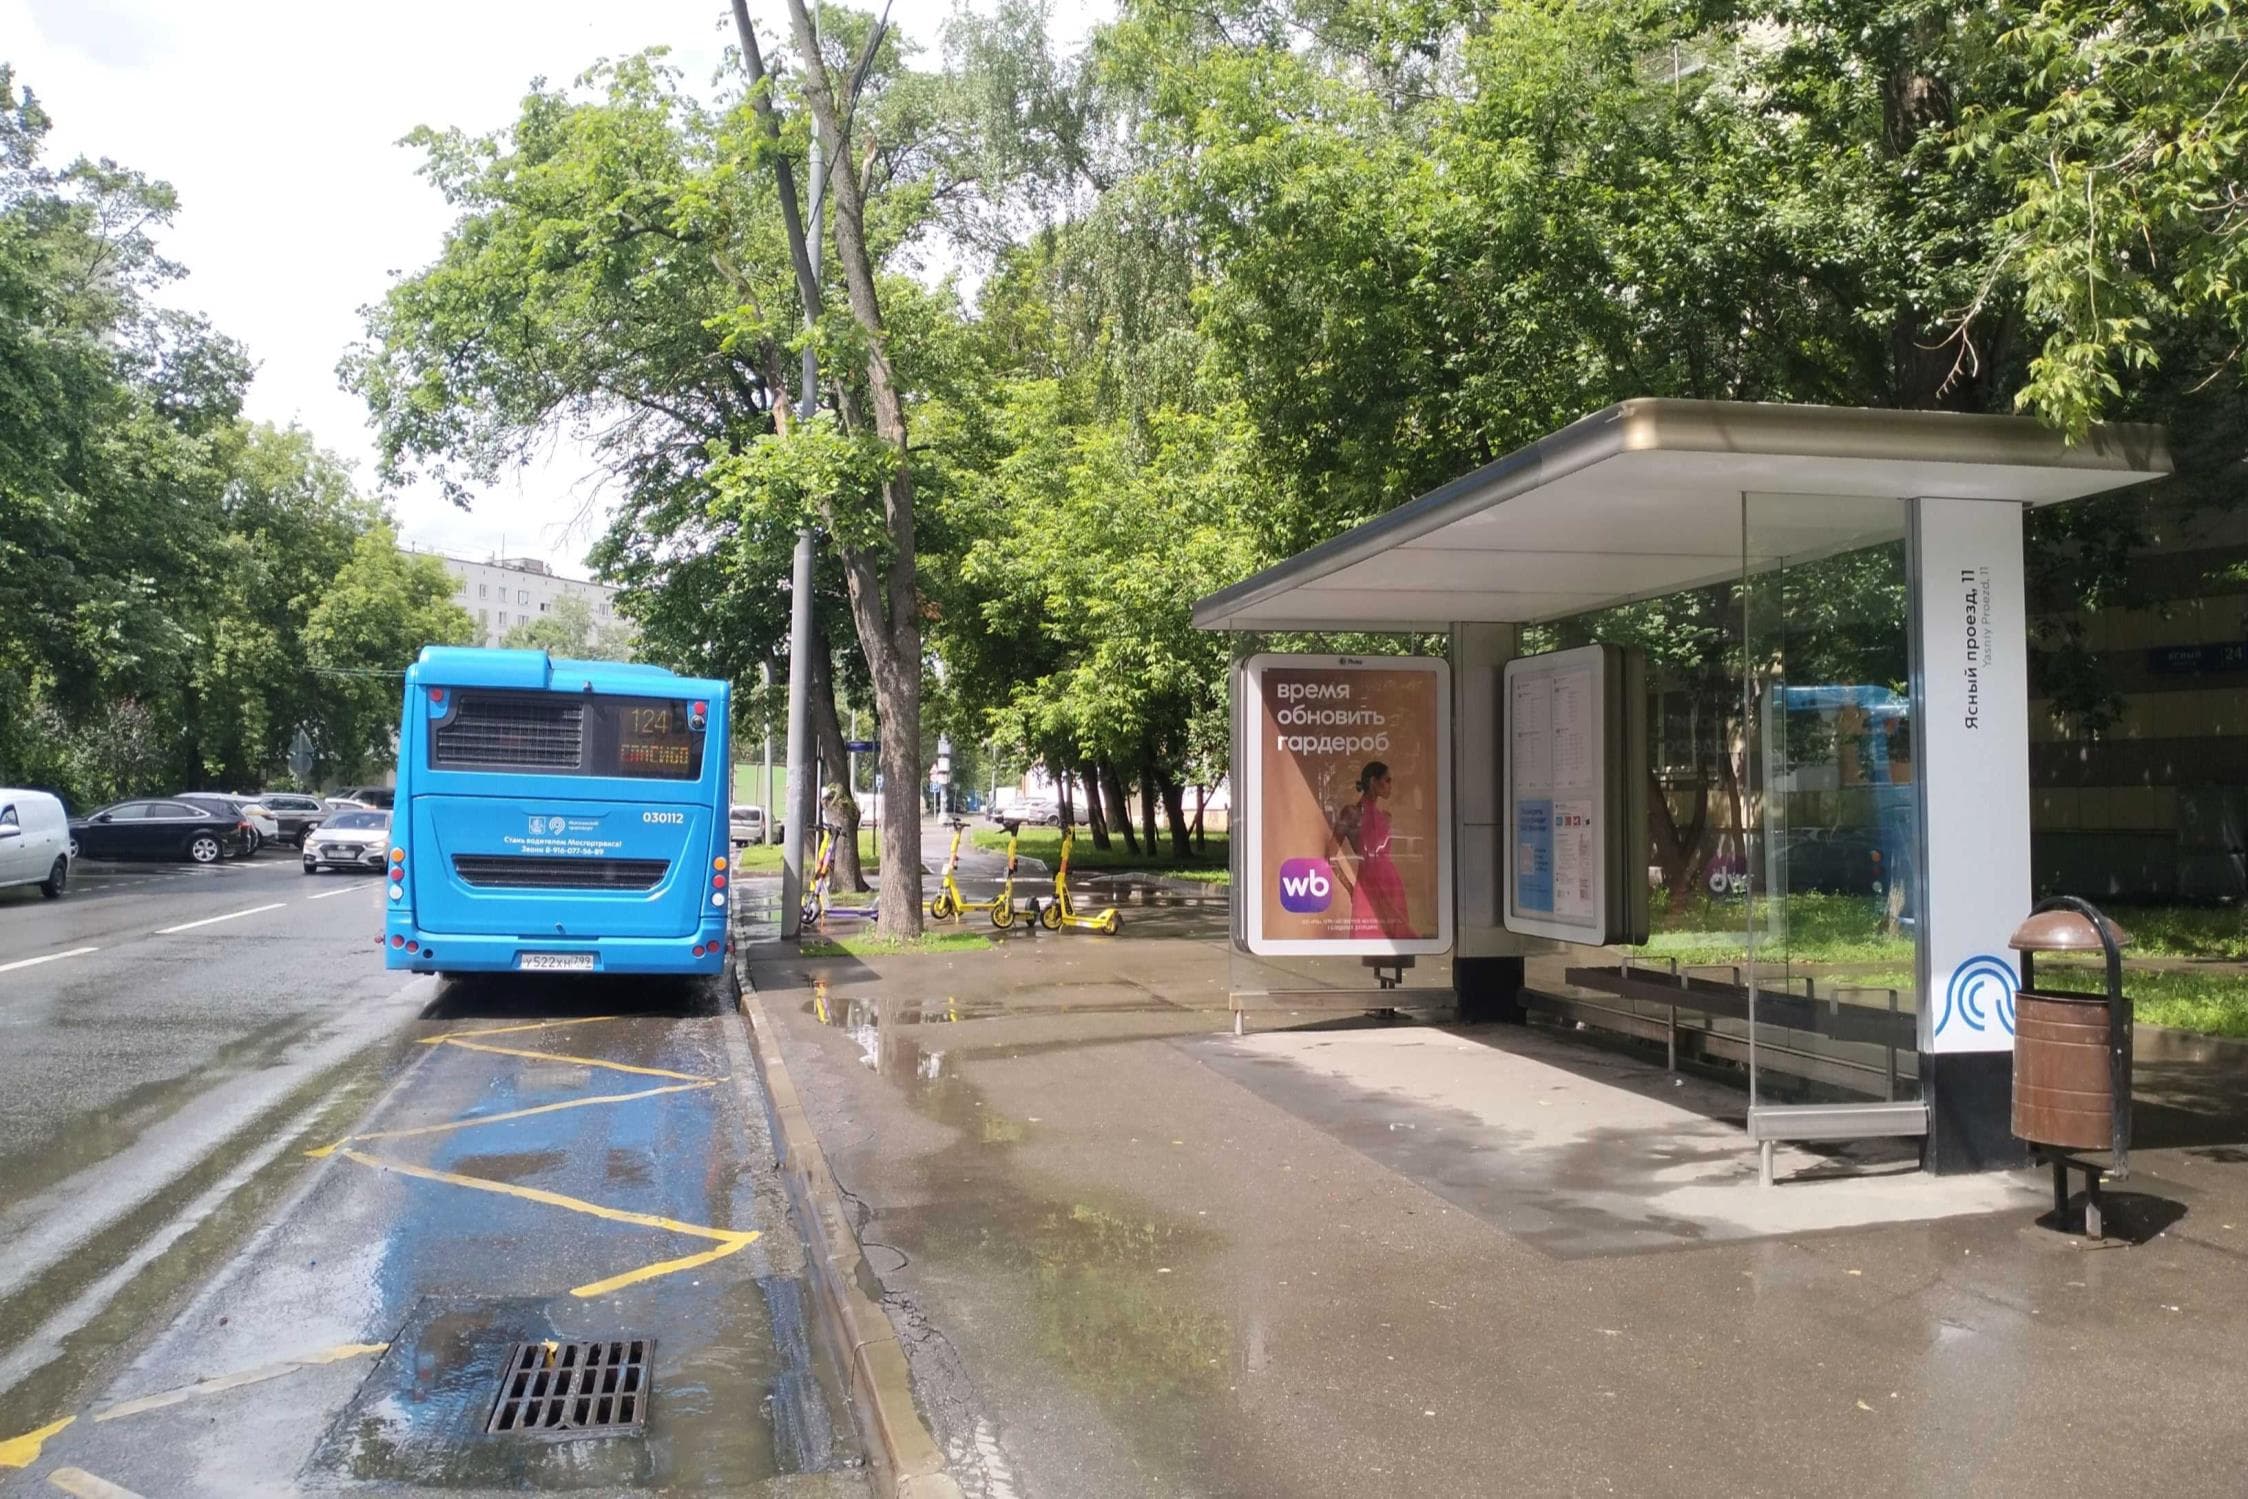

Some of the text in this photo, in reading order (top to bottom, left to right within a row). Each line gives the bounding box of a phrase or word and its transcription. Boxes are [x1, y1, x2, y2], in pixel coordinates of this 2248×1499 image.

[1961, 569, 1980, 729] Ясный проезд, 11
[1277, 683, 1350, 704] время
[632, 708, 668, 734] 124
[1277, 704, 1385, 725] обновить
[1277, 731, 1390, 756] гардероб
[643, 812, 684, 824] 030112
[1282, 868, 1330, 897] wb
